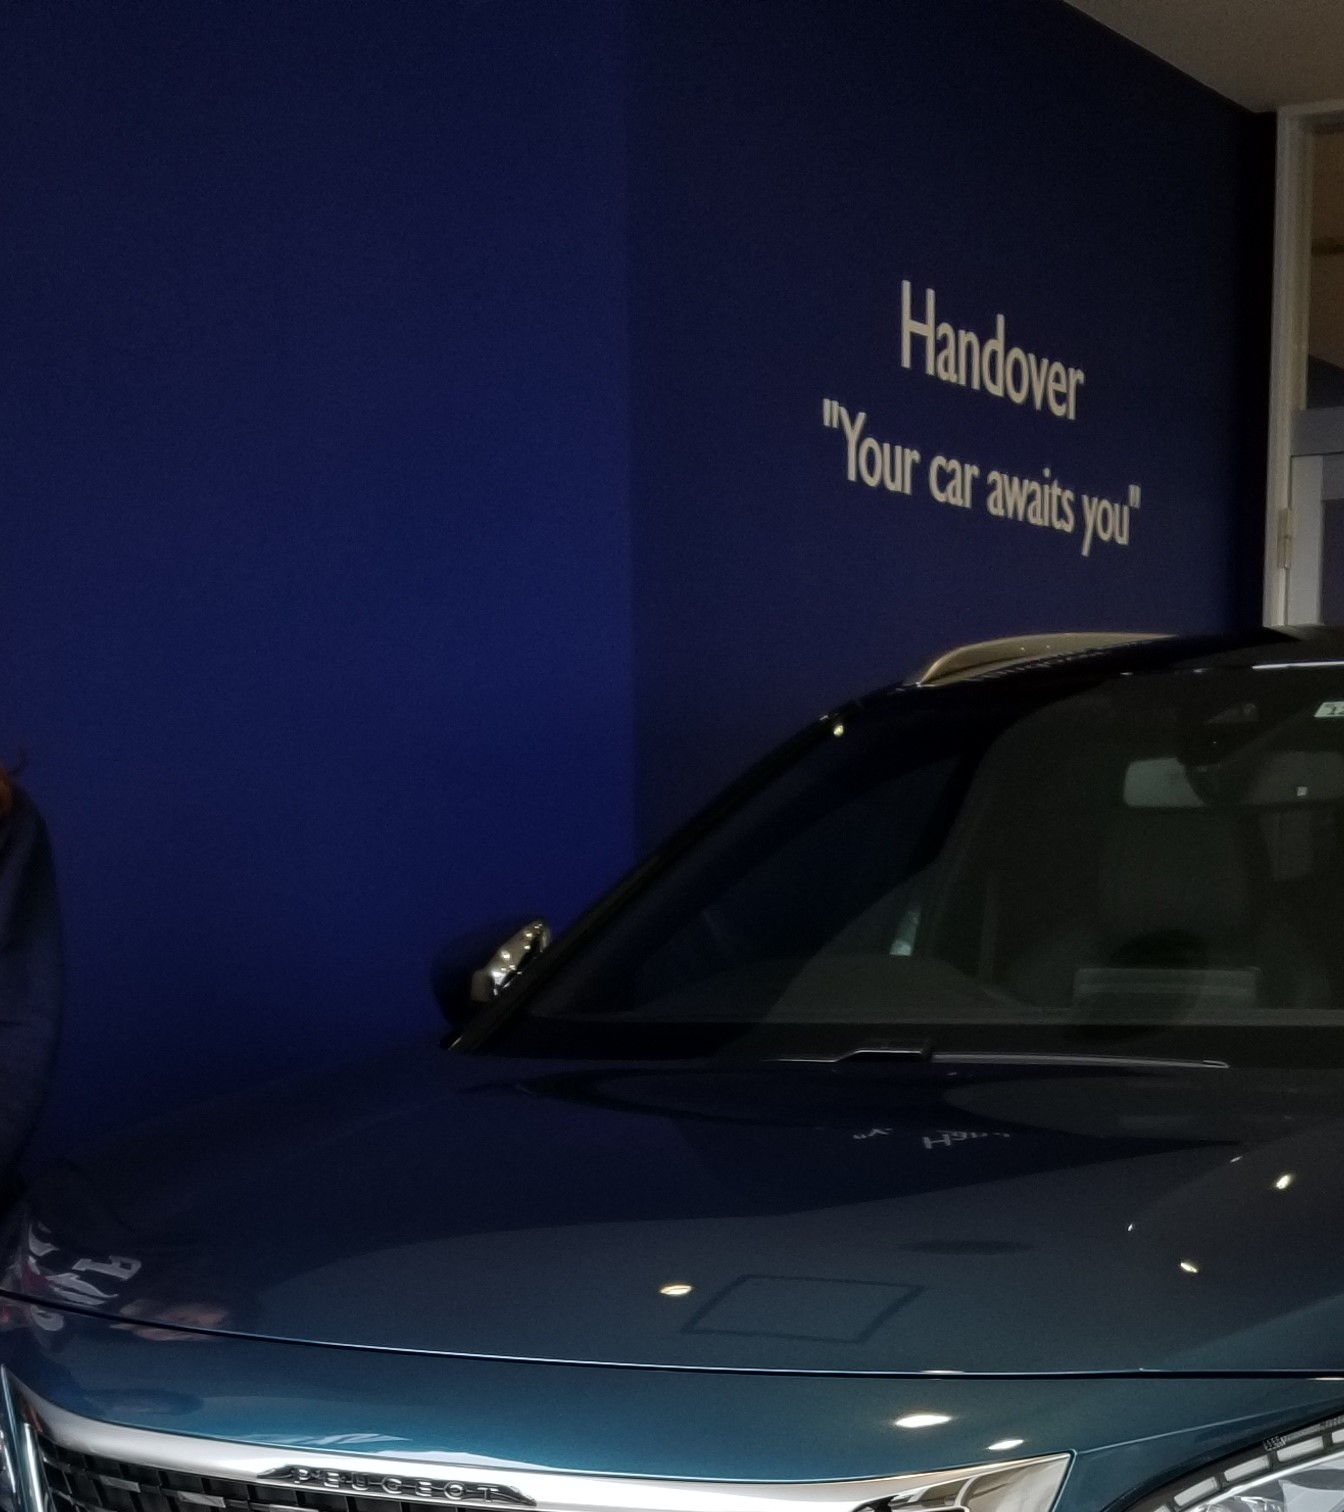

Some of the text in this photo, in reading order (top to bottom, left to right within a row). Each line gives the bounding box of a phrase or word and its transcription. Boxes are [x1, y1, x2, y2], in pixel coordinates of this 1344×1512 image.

[900, 279, 1086, 421] Handover
[822, 397, 1142, 557] "Your car awaits you"
[293, 1468, 500, 1503] PEUGEOT
